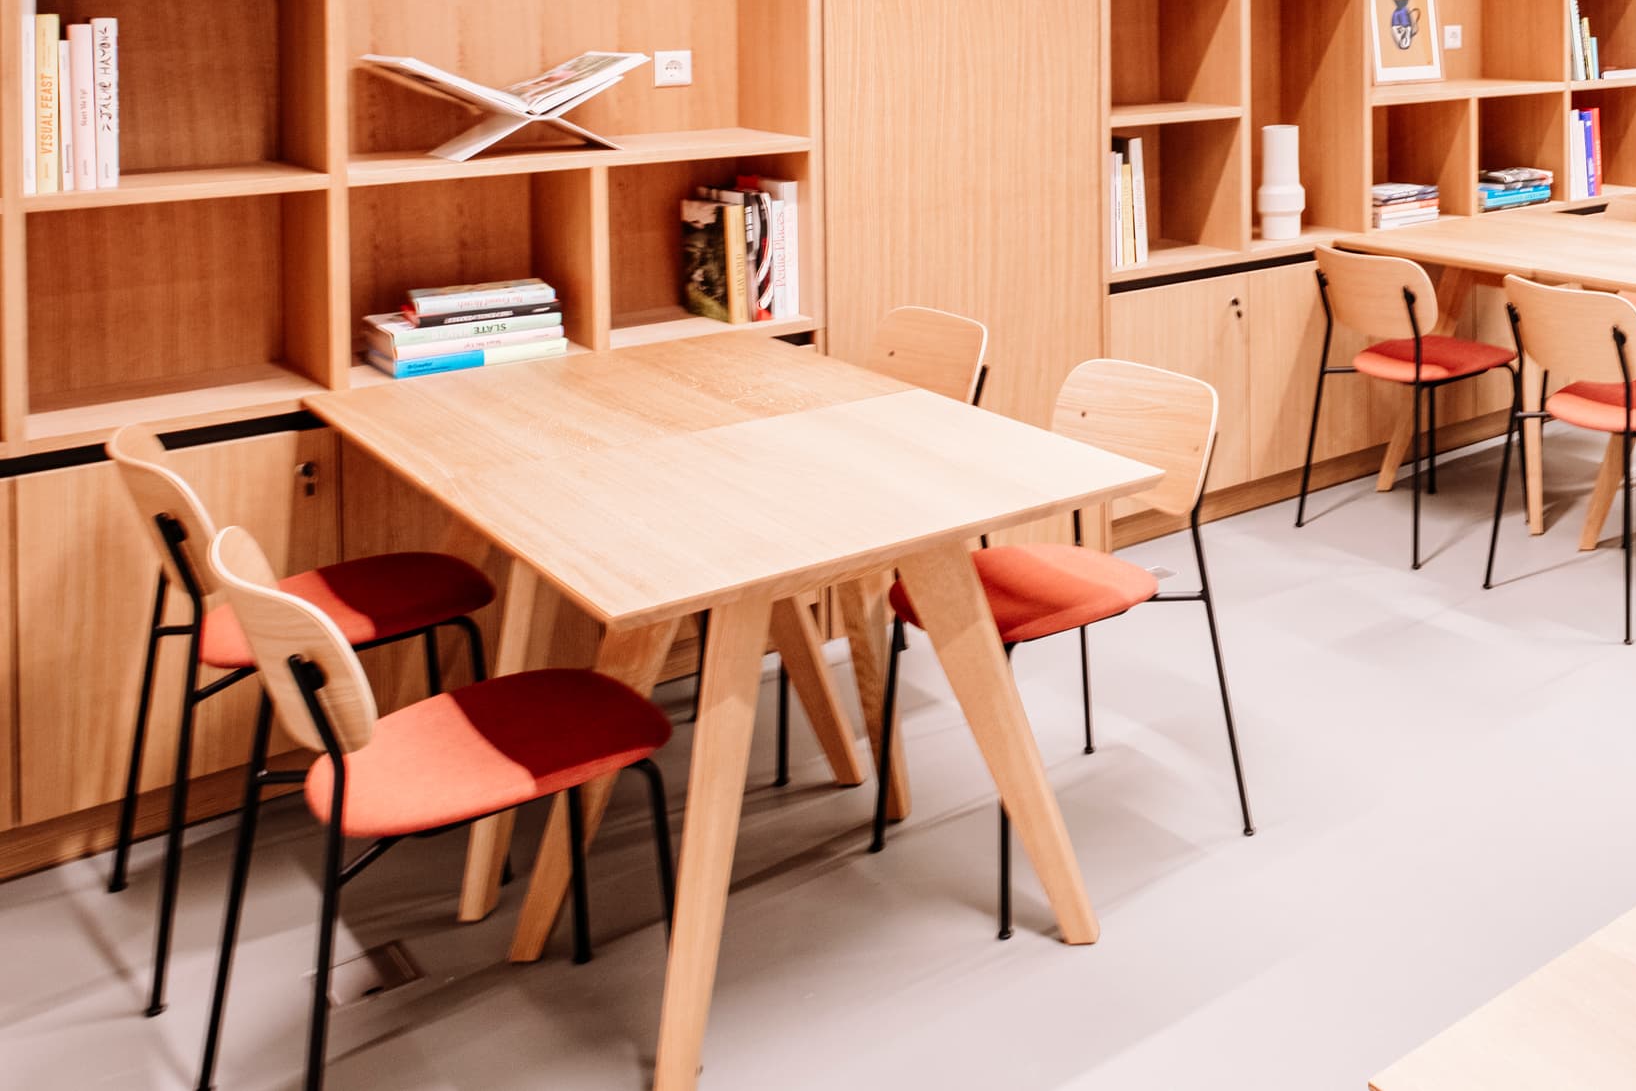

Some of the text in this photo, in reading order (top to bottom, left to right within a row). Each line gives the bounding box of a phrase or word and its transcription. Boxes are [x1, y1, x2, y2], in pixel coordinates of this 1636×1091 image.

[39, 73, 53, 109] FEAST
[40, 112, 53, 155] VISUAL
[473, 323, 507, 335] SLATE
